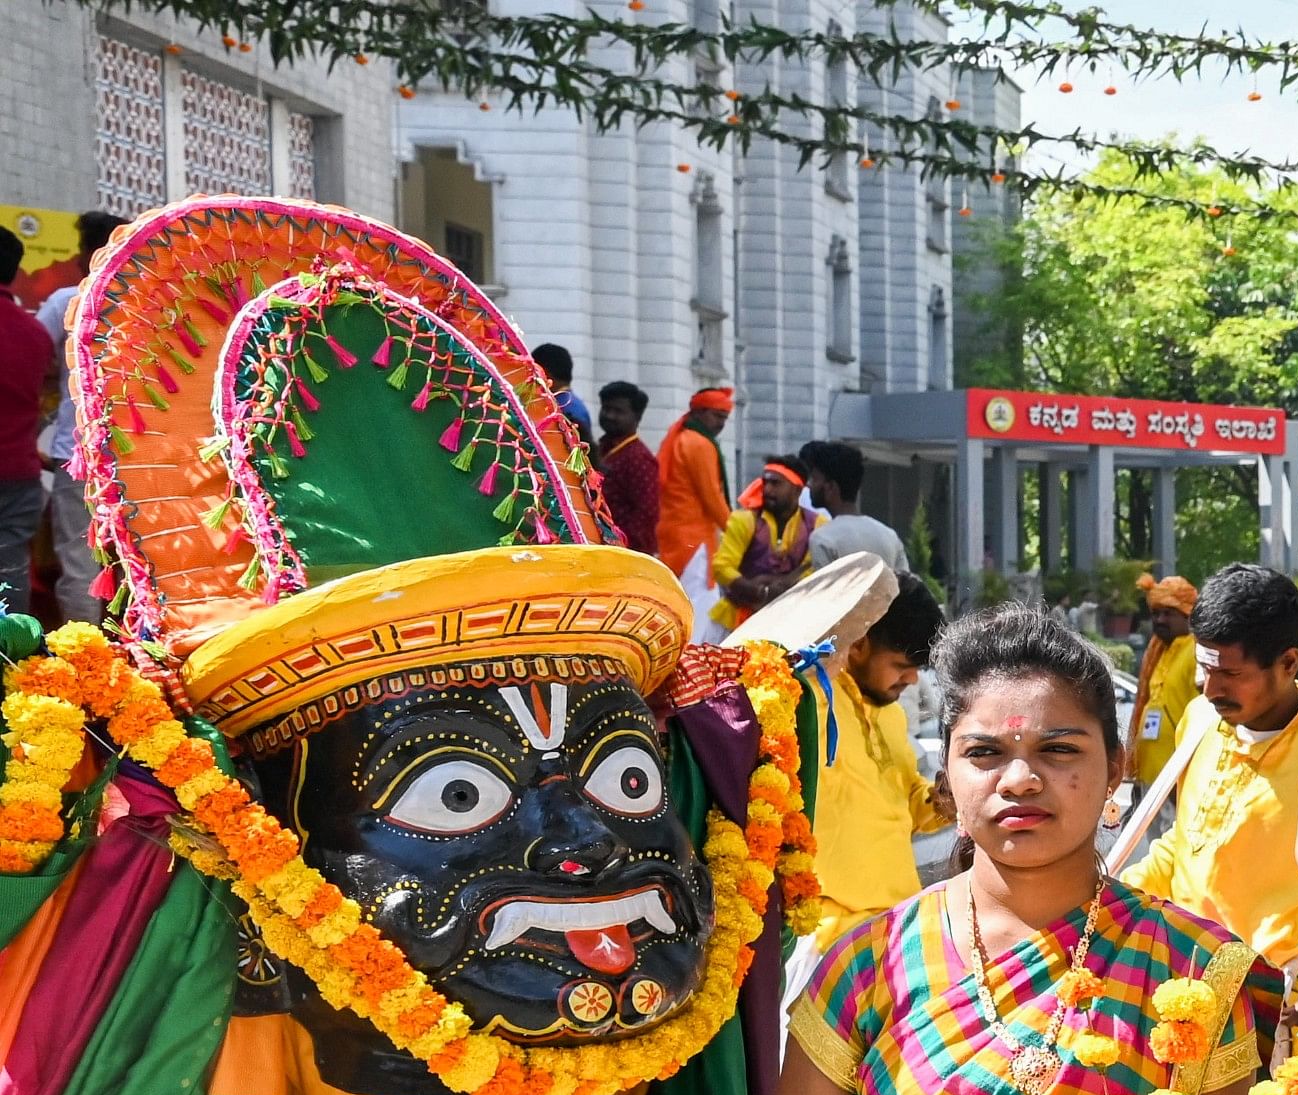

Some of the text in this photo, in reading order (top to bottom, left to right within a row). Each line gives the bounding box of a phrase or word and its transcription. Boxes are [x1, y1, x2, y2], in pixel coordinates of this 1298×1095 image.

[1029, 404, 1277, 447] ಕನ್ನಡ ಮತ್ತು ಸಂಸ್ಕೃತಿ ಇಲಾಖೆ
